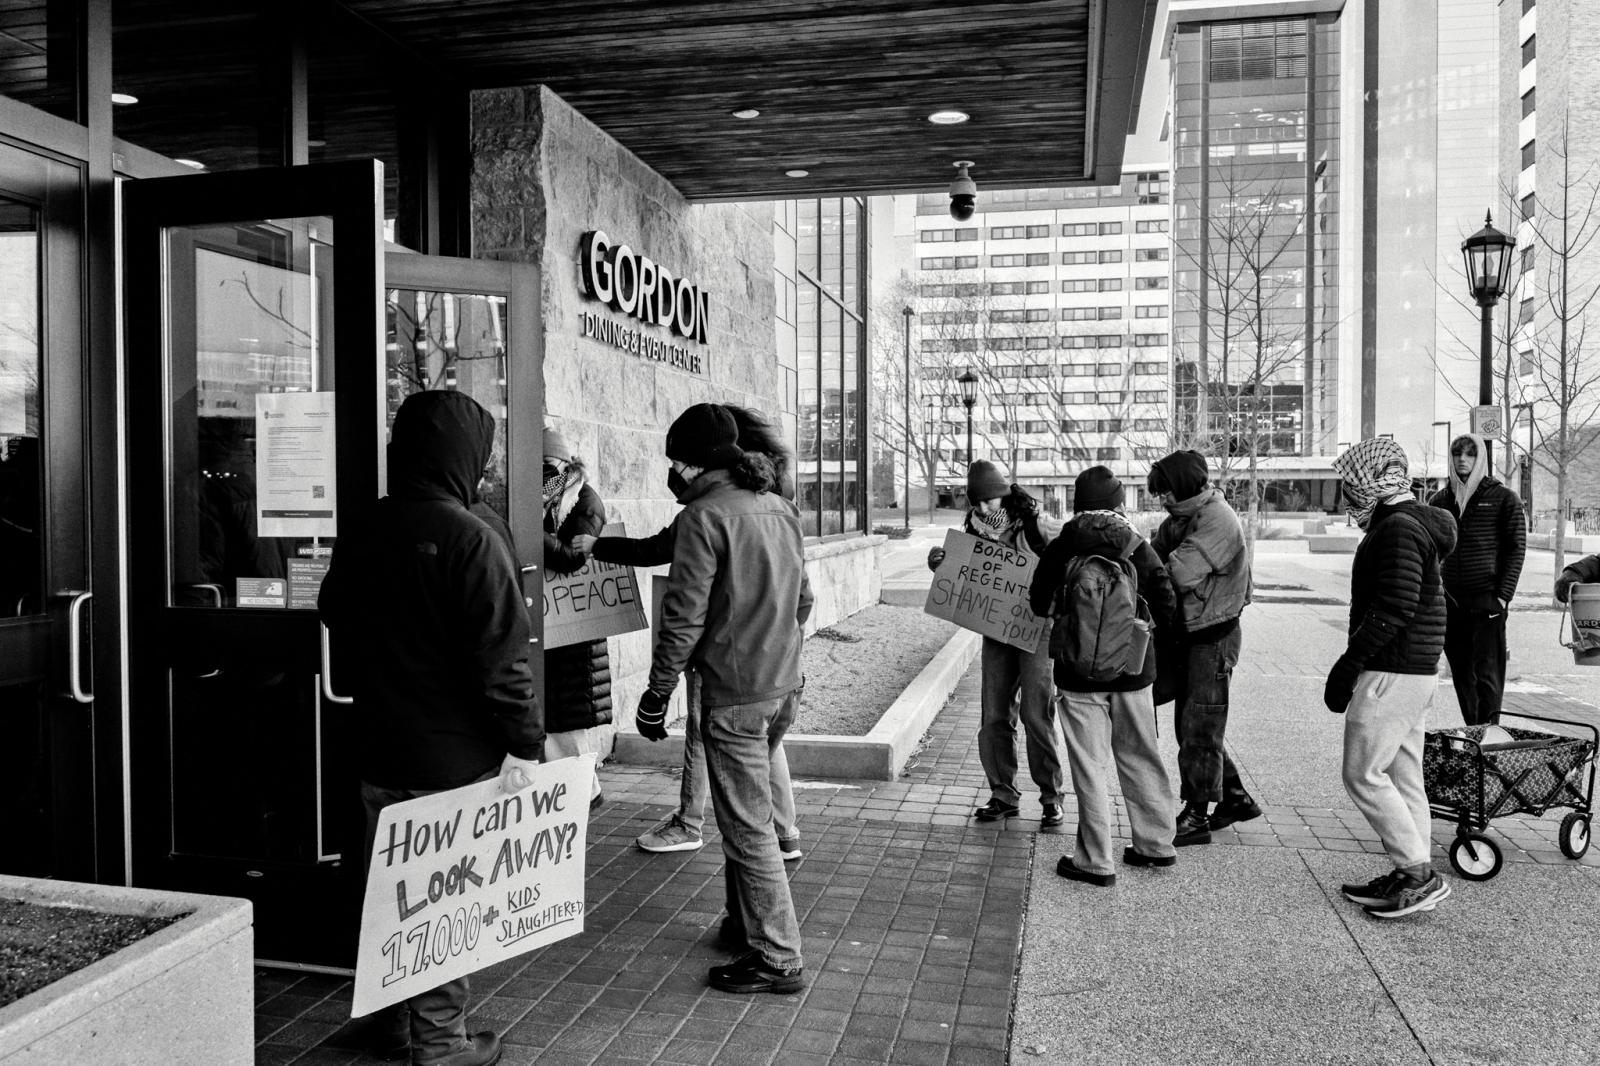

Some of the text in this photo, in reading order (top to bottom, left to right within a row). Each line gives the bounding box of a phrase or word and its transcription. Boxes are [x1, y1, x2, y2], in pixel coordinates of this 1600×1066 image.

[582, 231, 709, 345] GORDON
[584, 312, 701, 375] DINING & EVENT CENTER
[973, 540, 1028, 568] BOARD
[982, 561, 1003, 574] OF
[552, 576, 634, 616] PEACE
[932, 578, 1035, 625] SHAME ON
[1002, 620, 1039, 647] YOU!
[1576, 620, 1600, 628] ARD
[473, 795, 523, 839] can
[532, 783, 567, 818] we
[489, 822, 578, 885] AWAY?
[382, 883, 541, 988] 17,000+ KIDS
[496, 900, 584, 943] SLAUGHTERED
